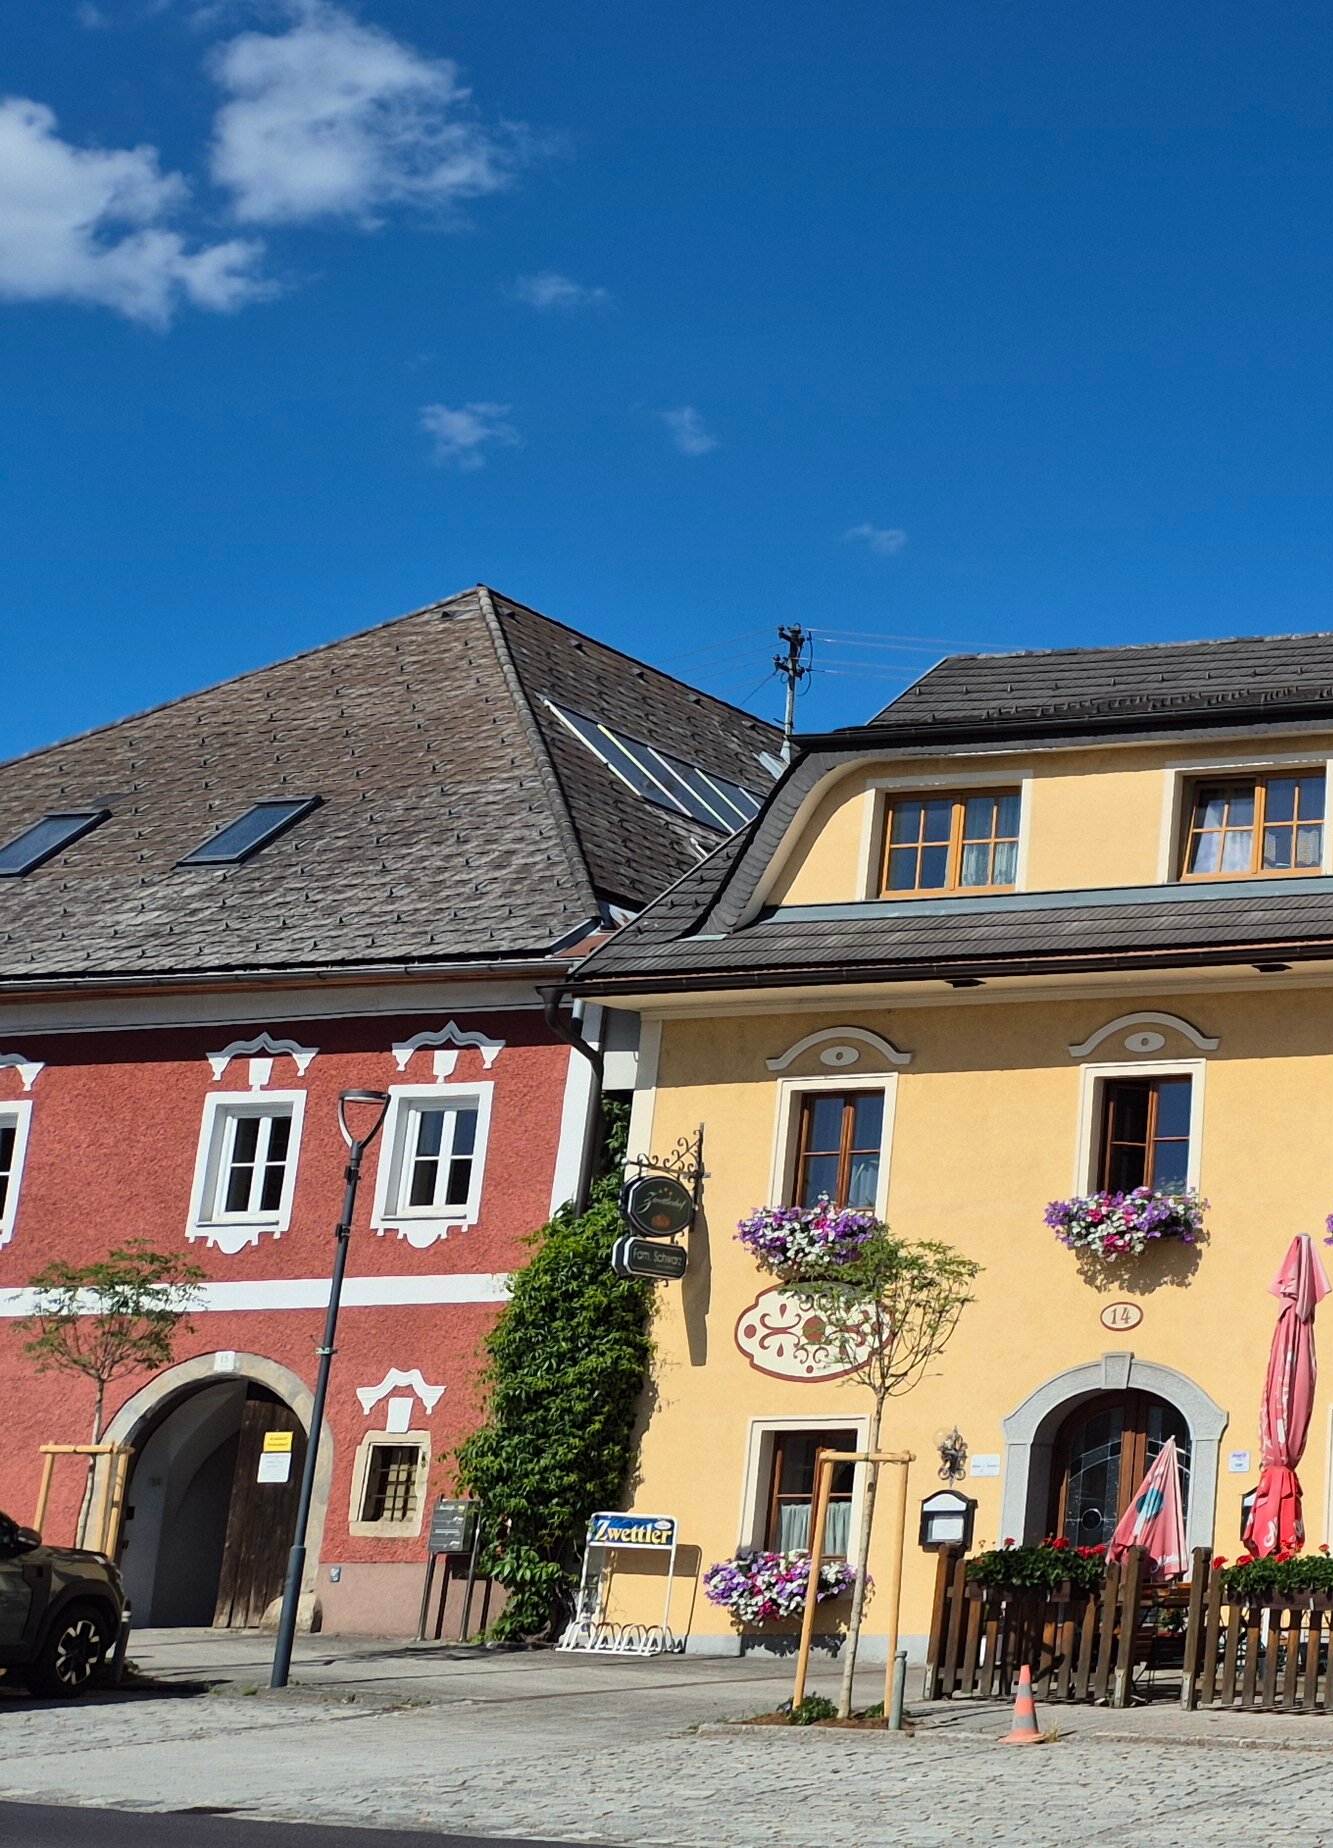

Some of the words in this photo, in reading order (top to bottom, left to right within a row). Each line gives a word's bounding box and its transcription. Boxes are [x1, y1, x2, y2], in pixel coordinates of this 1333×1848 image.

[653, 1250, 682, 1266] Schwarz
[1110, 1306, 1131, 1325] 14
[594, 1519, 673, 1544] Zwettler
